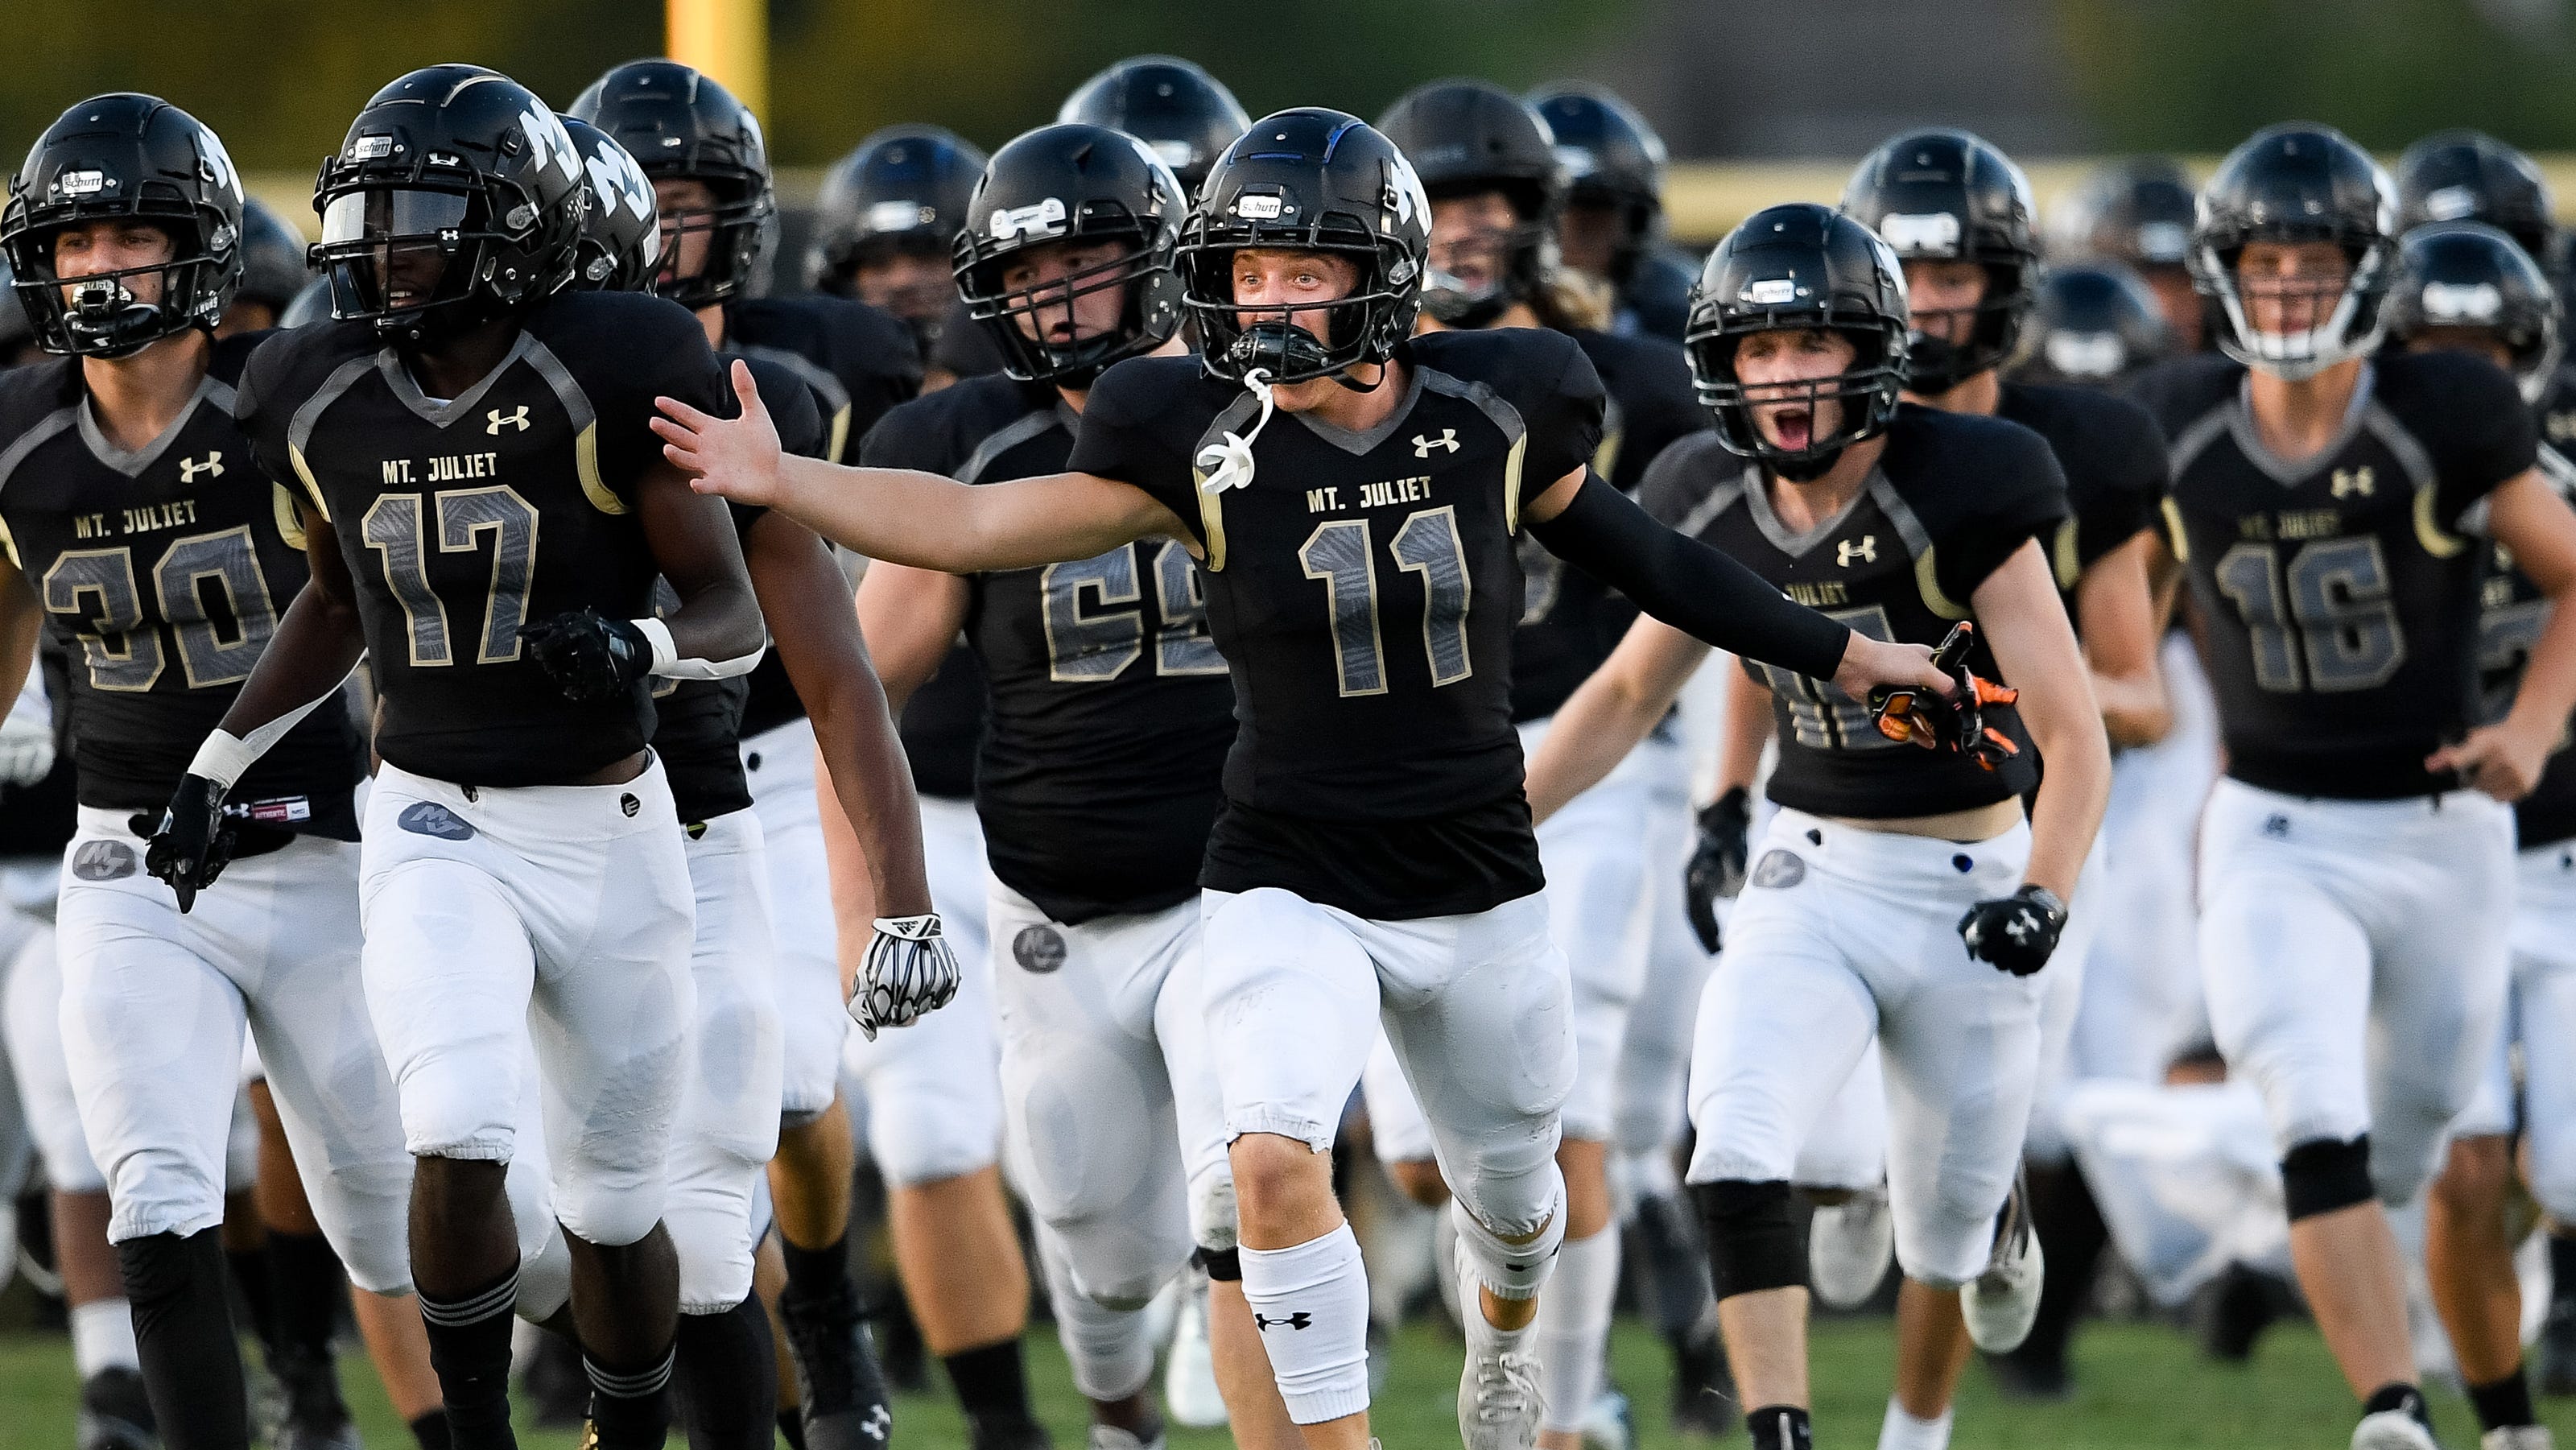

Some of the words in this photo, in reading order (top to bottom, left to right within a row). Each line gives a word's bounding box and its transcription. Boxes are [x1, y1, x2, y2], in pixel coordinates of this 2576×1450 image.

[74, 514, 111, 539] MT.
[123, 500, 196, 534] JULIET
[382, 460, 416, 483] MT.
[428, 452, 497, 481] JULIET
[1307, 487, 1346, 513] MT.
[1360, 476, 1431, 508] JULIET
[43, 523, 278, 692] 30
[361, 484, 539, 667] 17
[1298, 505, 1472, 697] 11
[2215, 535, 2406, 691] 16
